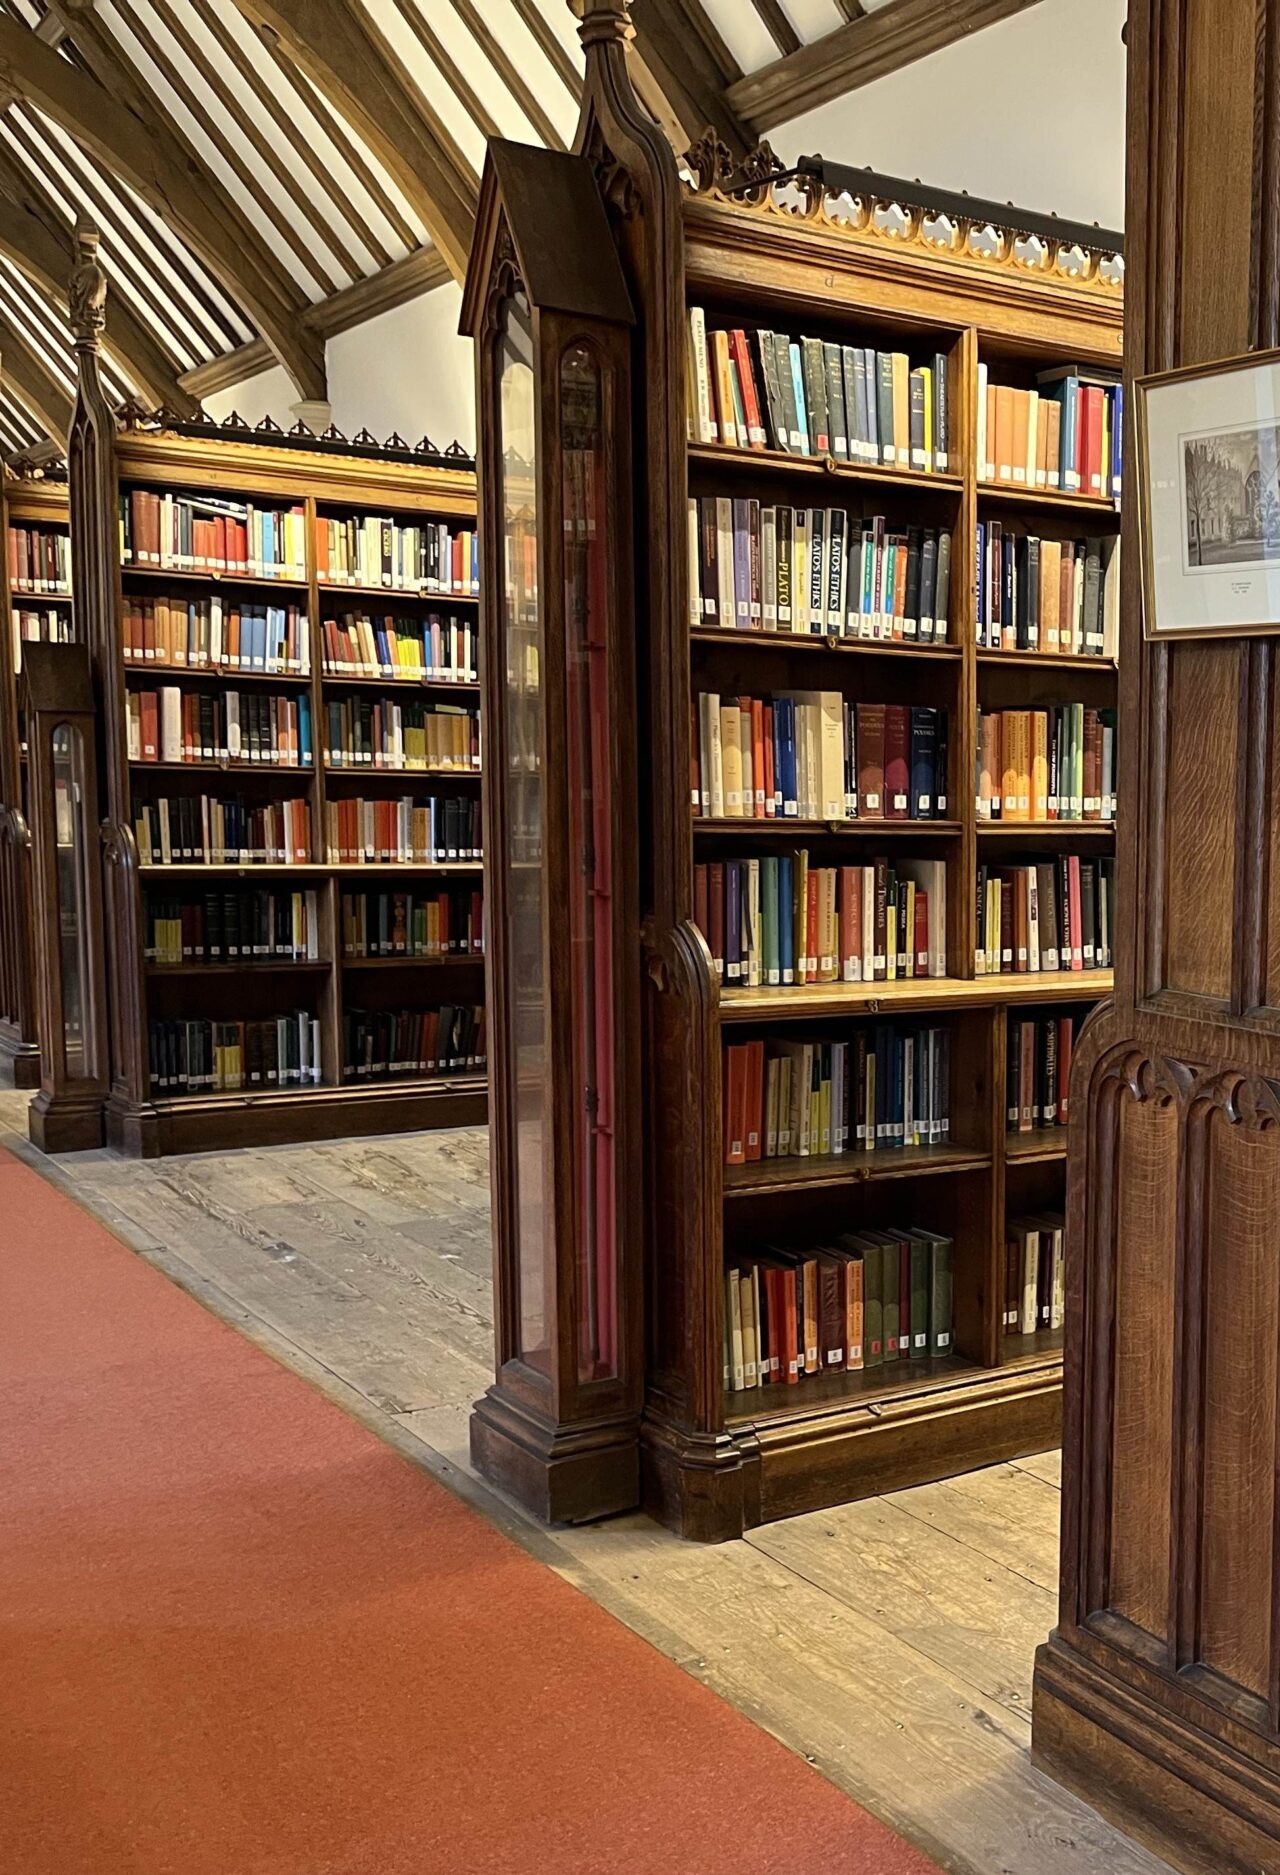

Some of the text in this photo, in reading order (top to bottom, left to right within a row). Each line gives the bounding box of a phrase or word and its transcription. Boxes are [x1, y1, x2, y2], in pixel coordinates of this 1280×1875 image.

[778, 562, 789, 606] PLATO
[811, 573, 821, 609] ETHICS
[829, 573, 840, 610] ETHICS
[878, 888, 887, 928] TROADES
